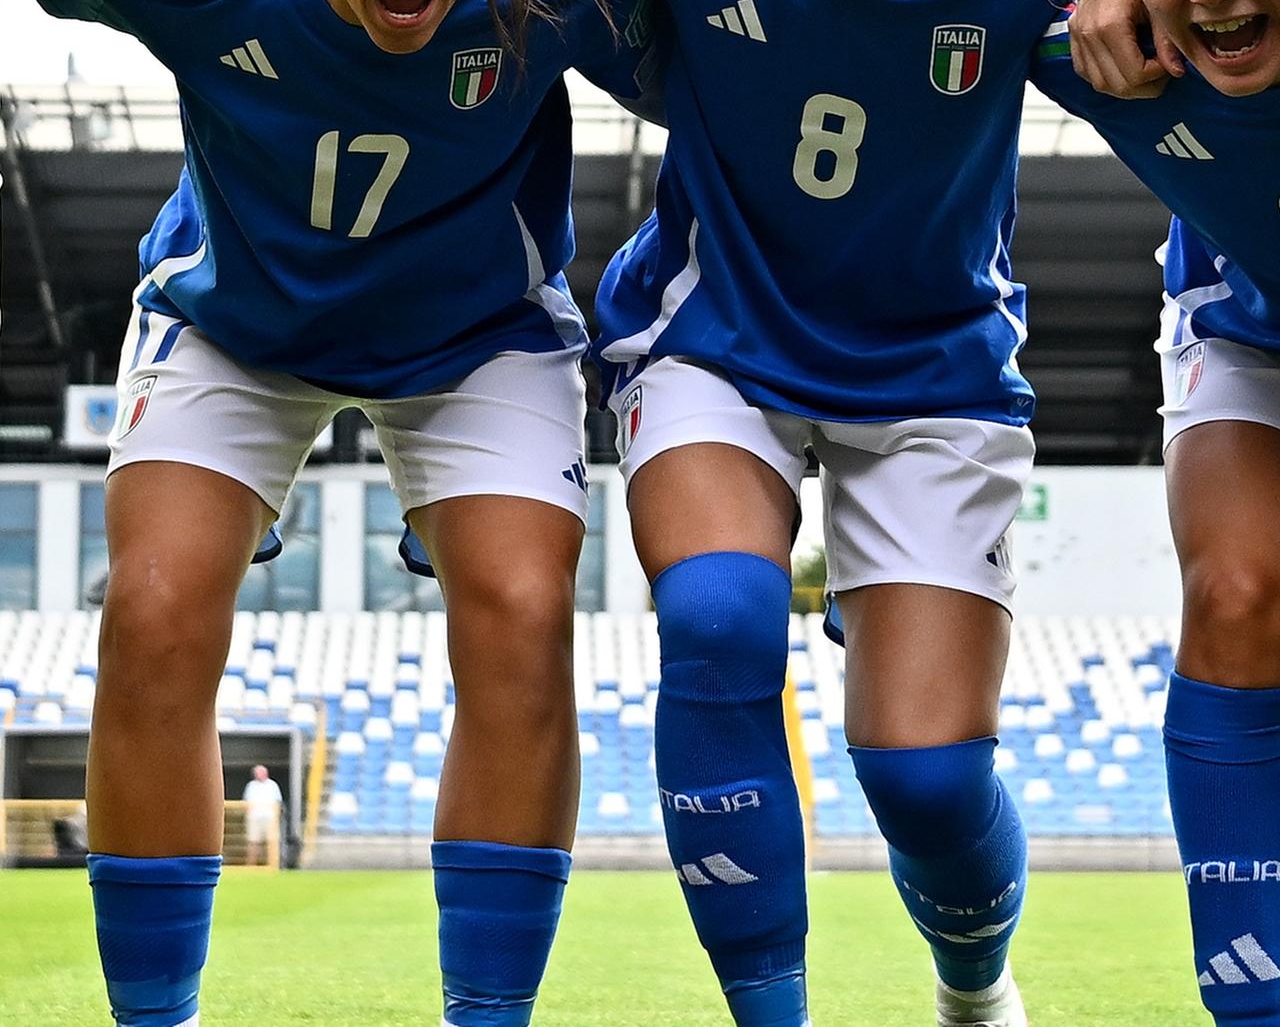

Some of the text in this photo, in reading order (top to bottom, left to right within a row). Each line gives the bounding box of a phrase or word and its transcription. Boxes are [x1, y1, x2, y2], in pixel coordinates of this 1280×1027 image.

[457, 52, 497, 69] ITALIA
[937, 30, 980, 45] ITALIA
[792, 93, 867, 200] 8
[310, 130, 411, 238] 17
